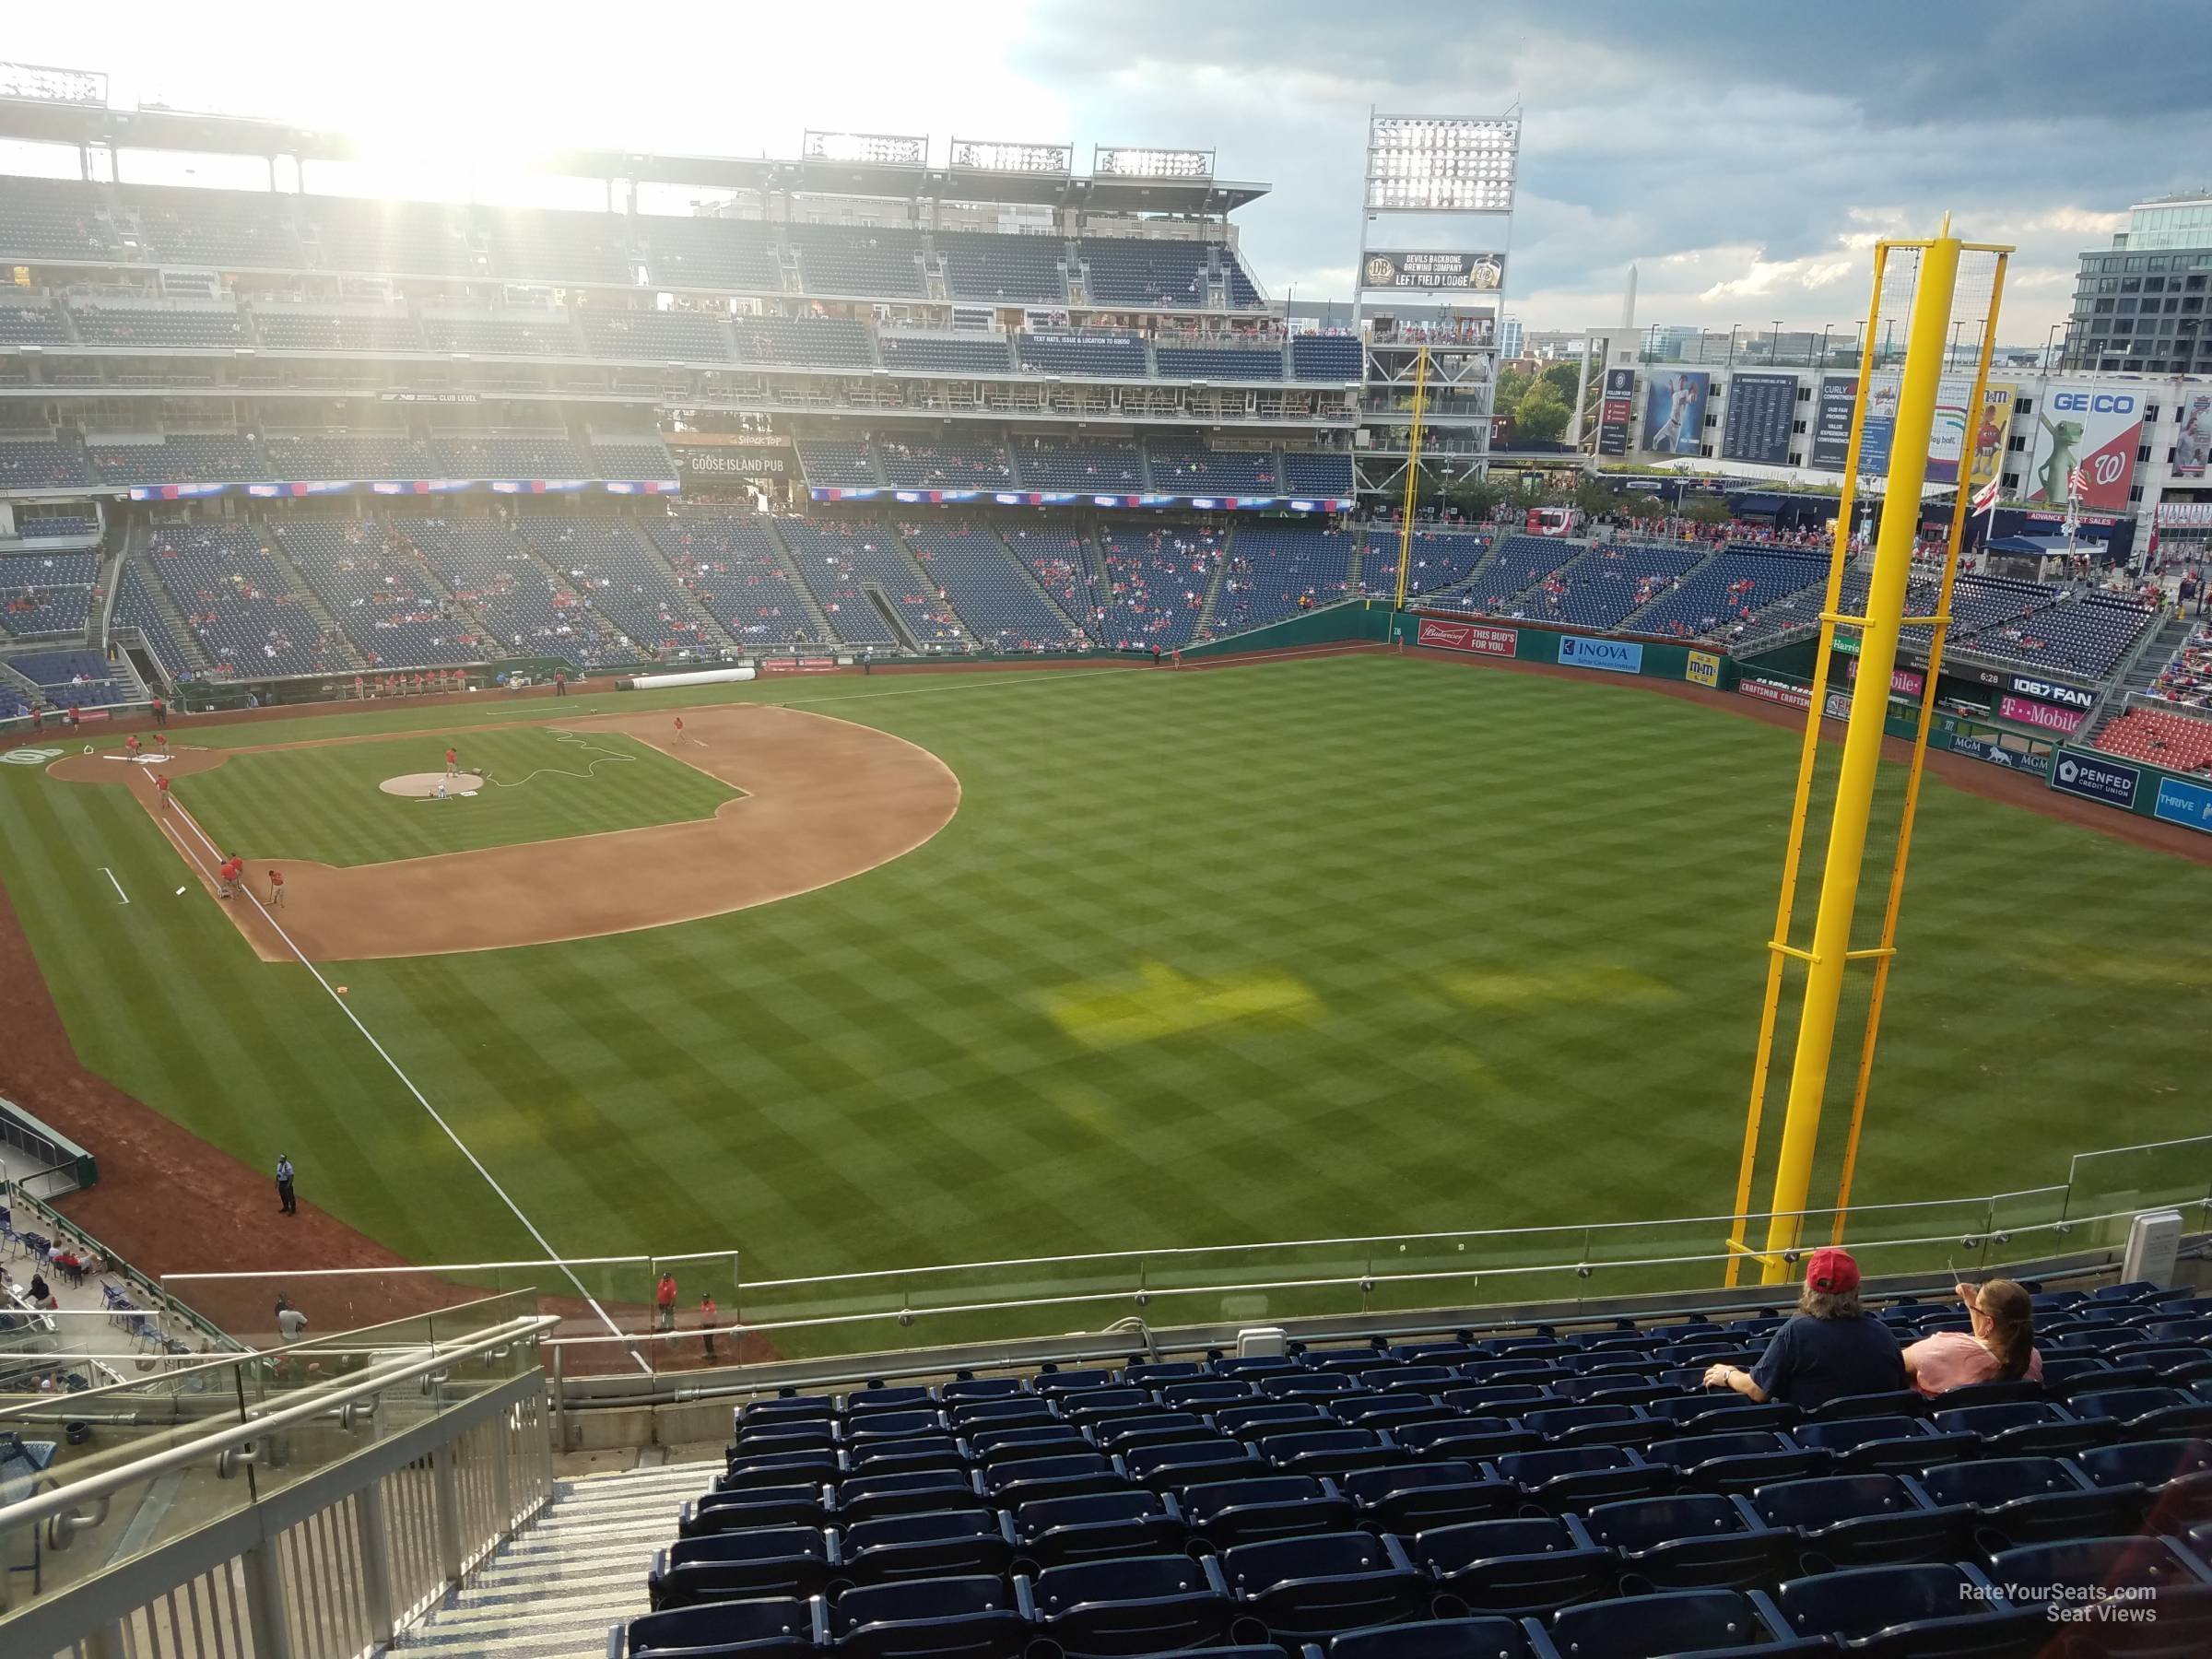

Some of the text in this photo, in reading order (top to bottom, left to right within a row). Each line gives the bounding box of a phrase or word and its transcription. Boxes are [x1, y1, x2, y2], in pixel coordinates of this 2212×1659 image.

[1406, 254, 1462, 264] DEVILS BACKBONE
[1371, 260, 1388, 276] DB
[1404, 264, 1463, 272] BREWING COMPANY
[1395, 275, 1416, 286] LEFT
[1418, 275, 1440, 286] FIELD
[1442, 275, 1468, 287] LODGE
[1824, 385, 1848, 394] CURLY
[439, 394, 456, 402] CLUB
[692, 457, 783, 472] GOOSE ISLAND PUB
[2030, 512, 2063, 522] ADVANCE
[1426, 628, 1465, 641] Budweiser
[1473, 629, 1515, 642] THIS BUD'S
[1471, 640, 1505, 652] FOR YOU.
[1579, 642, 1628, 660] INOVA
[1980, 673, 1999, 684] 6:28
[1741, 683, 1811, 708] CRAFTSMAN CRAFTSM
[2053, 687, 2092, 707] FAN
[1955, 737, 1982, 752] MGM
[2020, 755, 2049, 771] MGM
[2079, 767, 2132, 790] PENFED
[2078, 779, 2129, 797] CREDIT UNION
[2159, 794, 2194, 811] THRIVE
